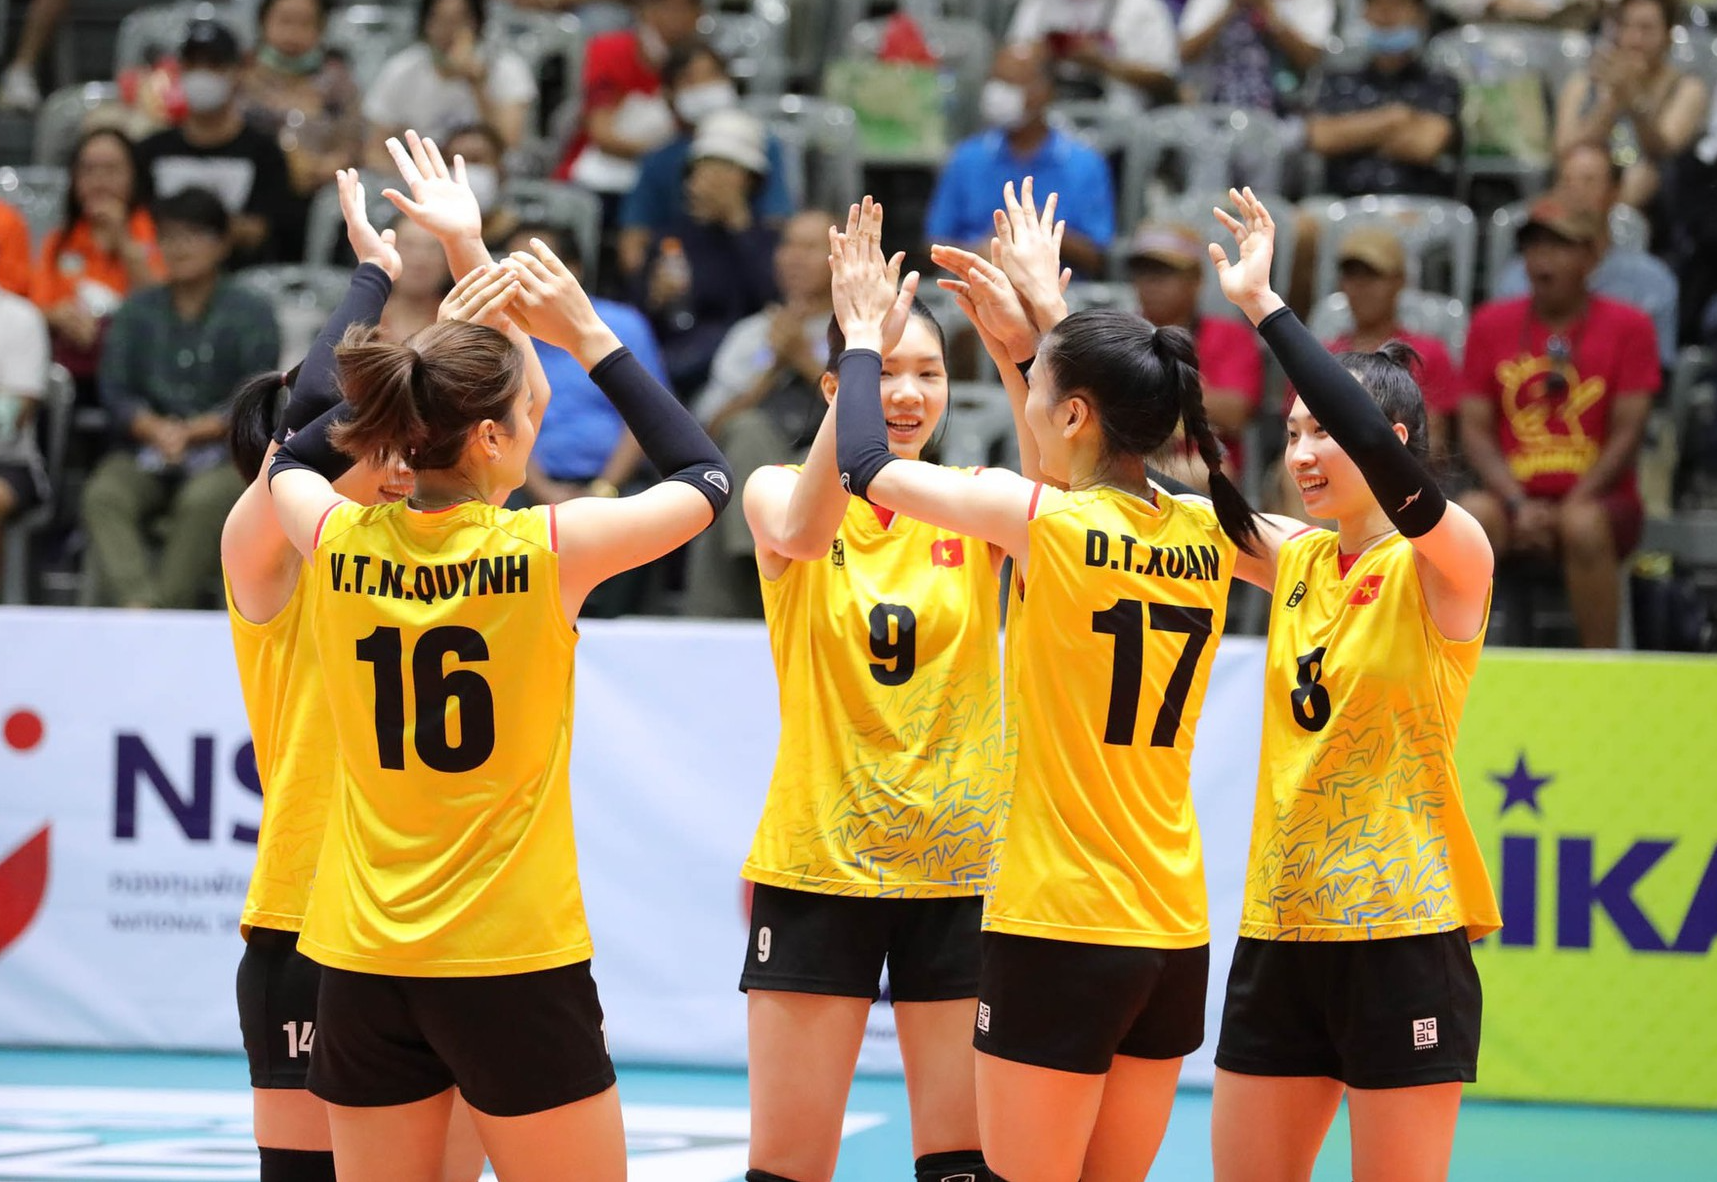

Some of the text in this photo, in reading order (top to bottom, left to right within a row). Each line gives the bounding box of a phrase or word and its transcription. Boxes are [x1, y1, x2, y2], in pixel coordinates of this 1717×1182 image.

[330, 553, 529, 604] V.T.N.QUYNH
[1085, 529, 1219, 581] D.T.XUAN
[869, 603, 916, 686] 9
[1092, 599, 1213, 747] 17
[356, 625, 495, 773] 16
[1290, 647, 1331, 732] 8
[757, 926, 772, 963] 9
[282, 1021, 315, 1059] 14
